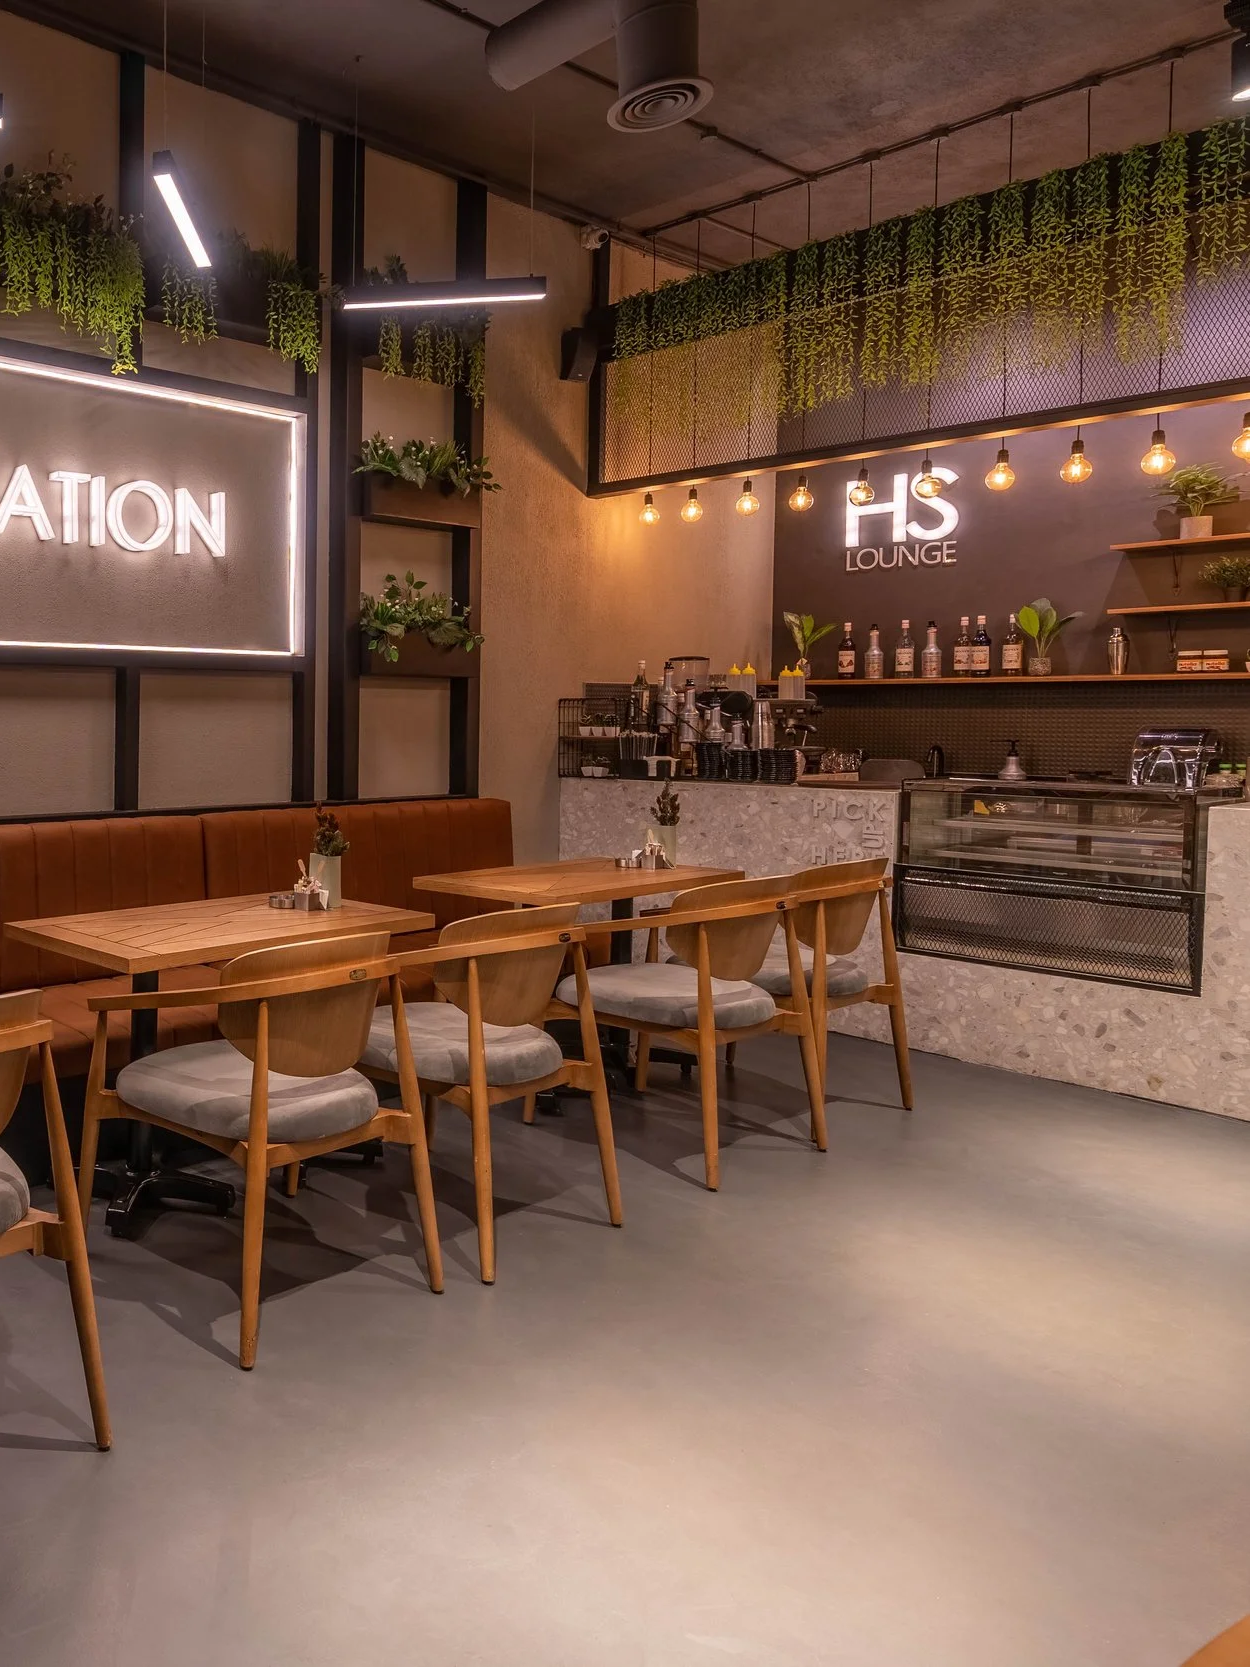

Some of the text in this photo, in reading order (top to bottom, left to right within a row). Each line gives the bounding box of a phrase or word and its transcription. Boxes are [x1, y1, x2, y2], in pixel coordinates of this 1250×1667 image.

[845, 466, 960, 548] HS
[845, 540, 958, 572] LOUNGE
[811, 799, 887, 822] PICK
[861, 823, 885, 849] UP
